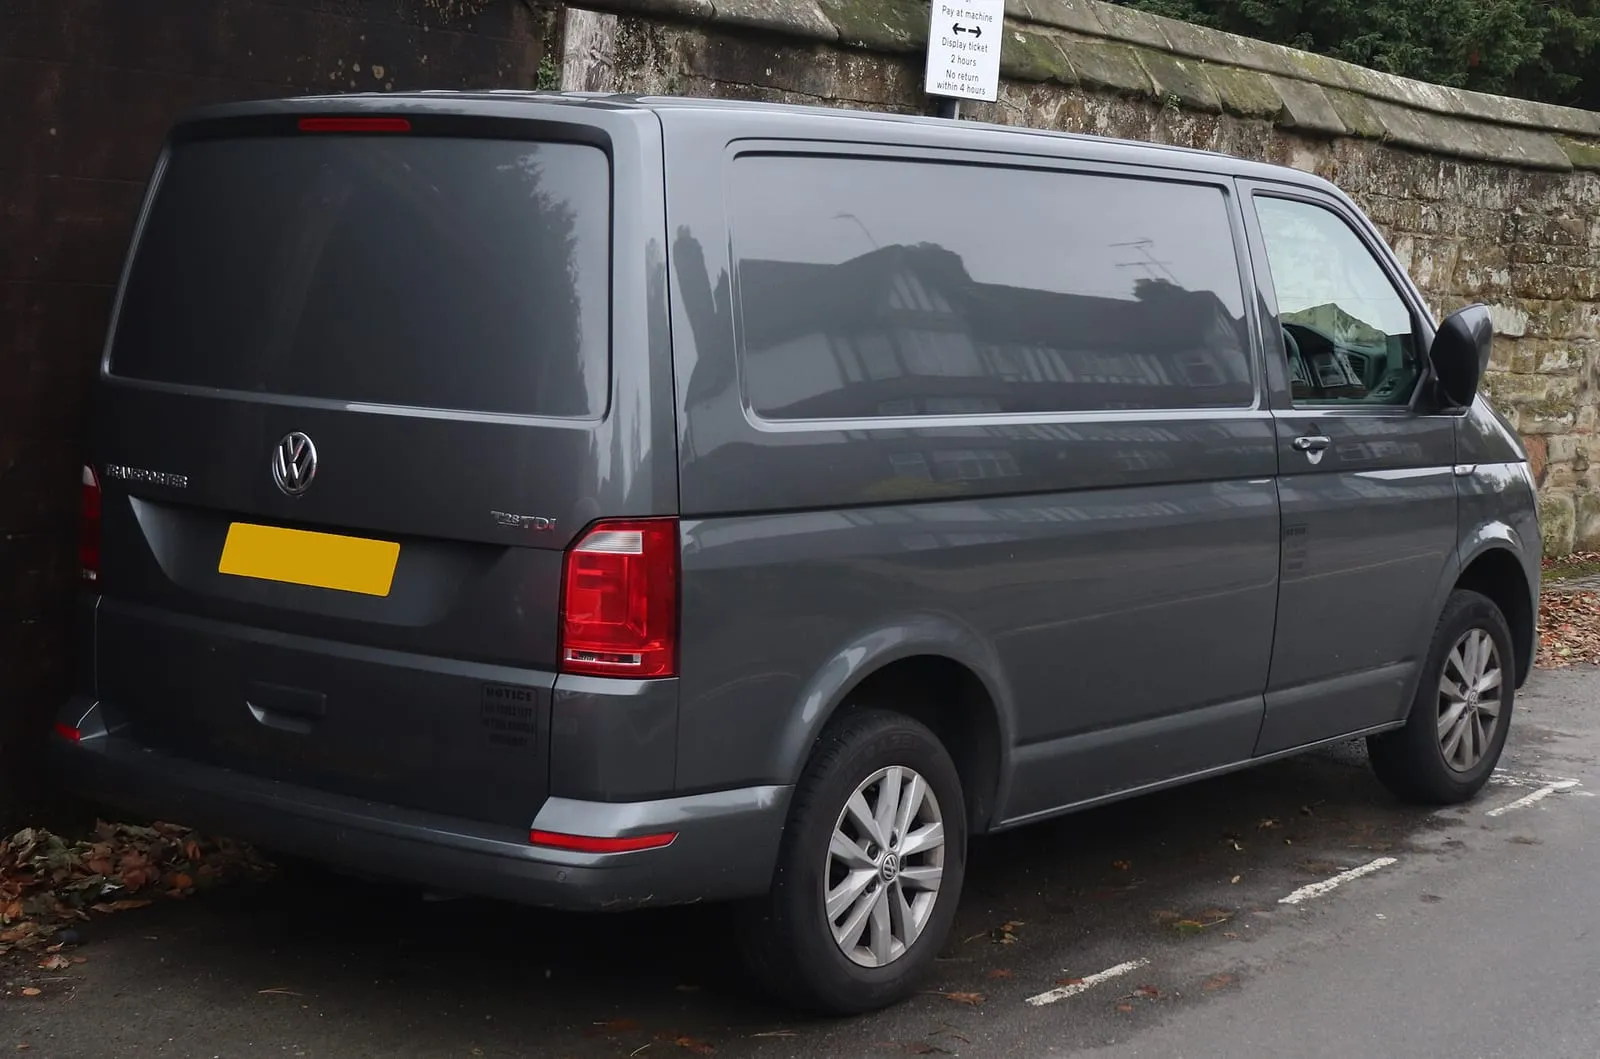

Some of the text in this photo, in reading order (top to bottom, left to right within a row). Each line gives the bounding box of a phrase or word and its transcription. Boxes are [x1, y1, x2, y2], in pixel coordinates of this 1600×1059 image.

[942, 5, 993, 22] Pay at machine
[941, 37, 988, 53] Display ticket
[951, 54, 977, 67] 2 hours
[946, 69, 979, 82] No return
[937, 81, 986, 95] within 4 hours
[486, 688, 533, 701] NOTICE
